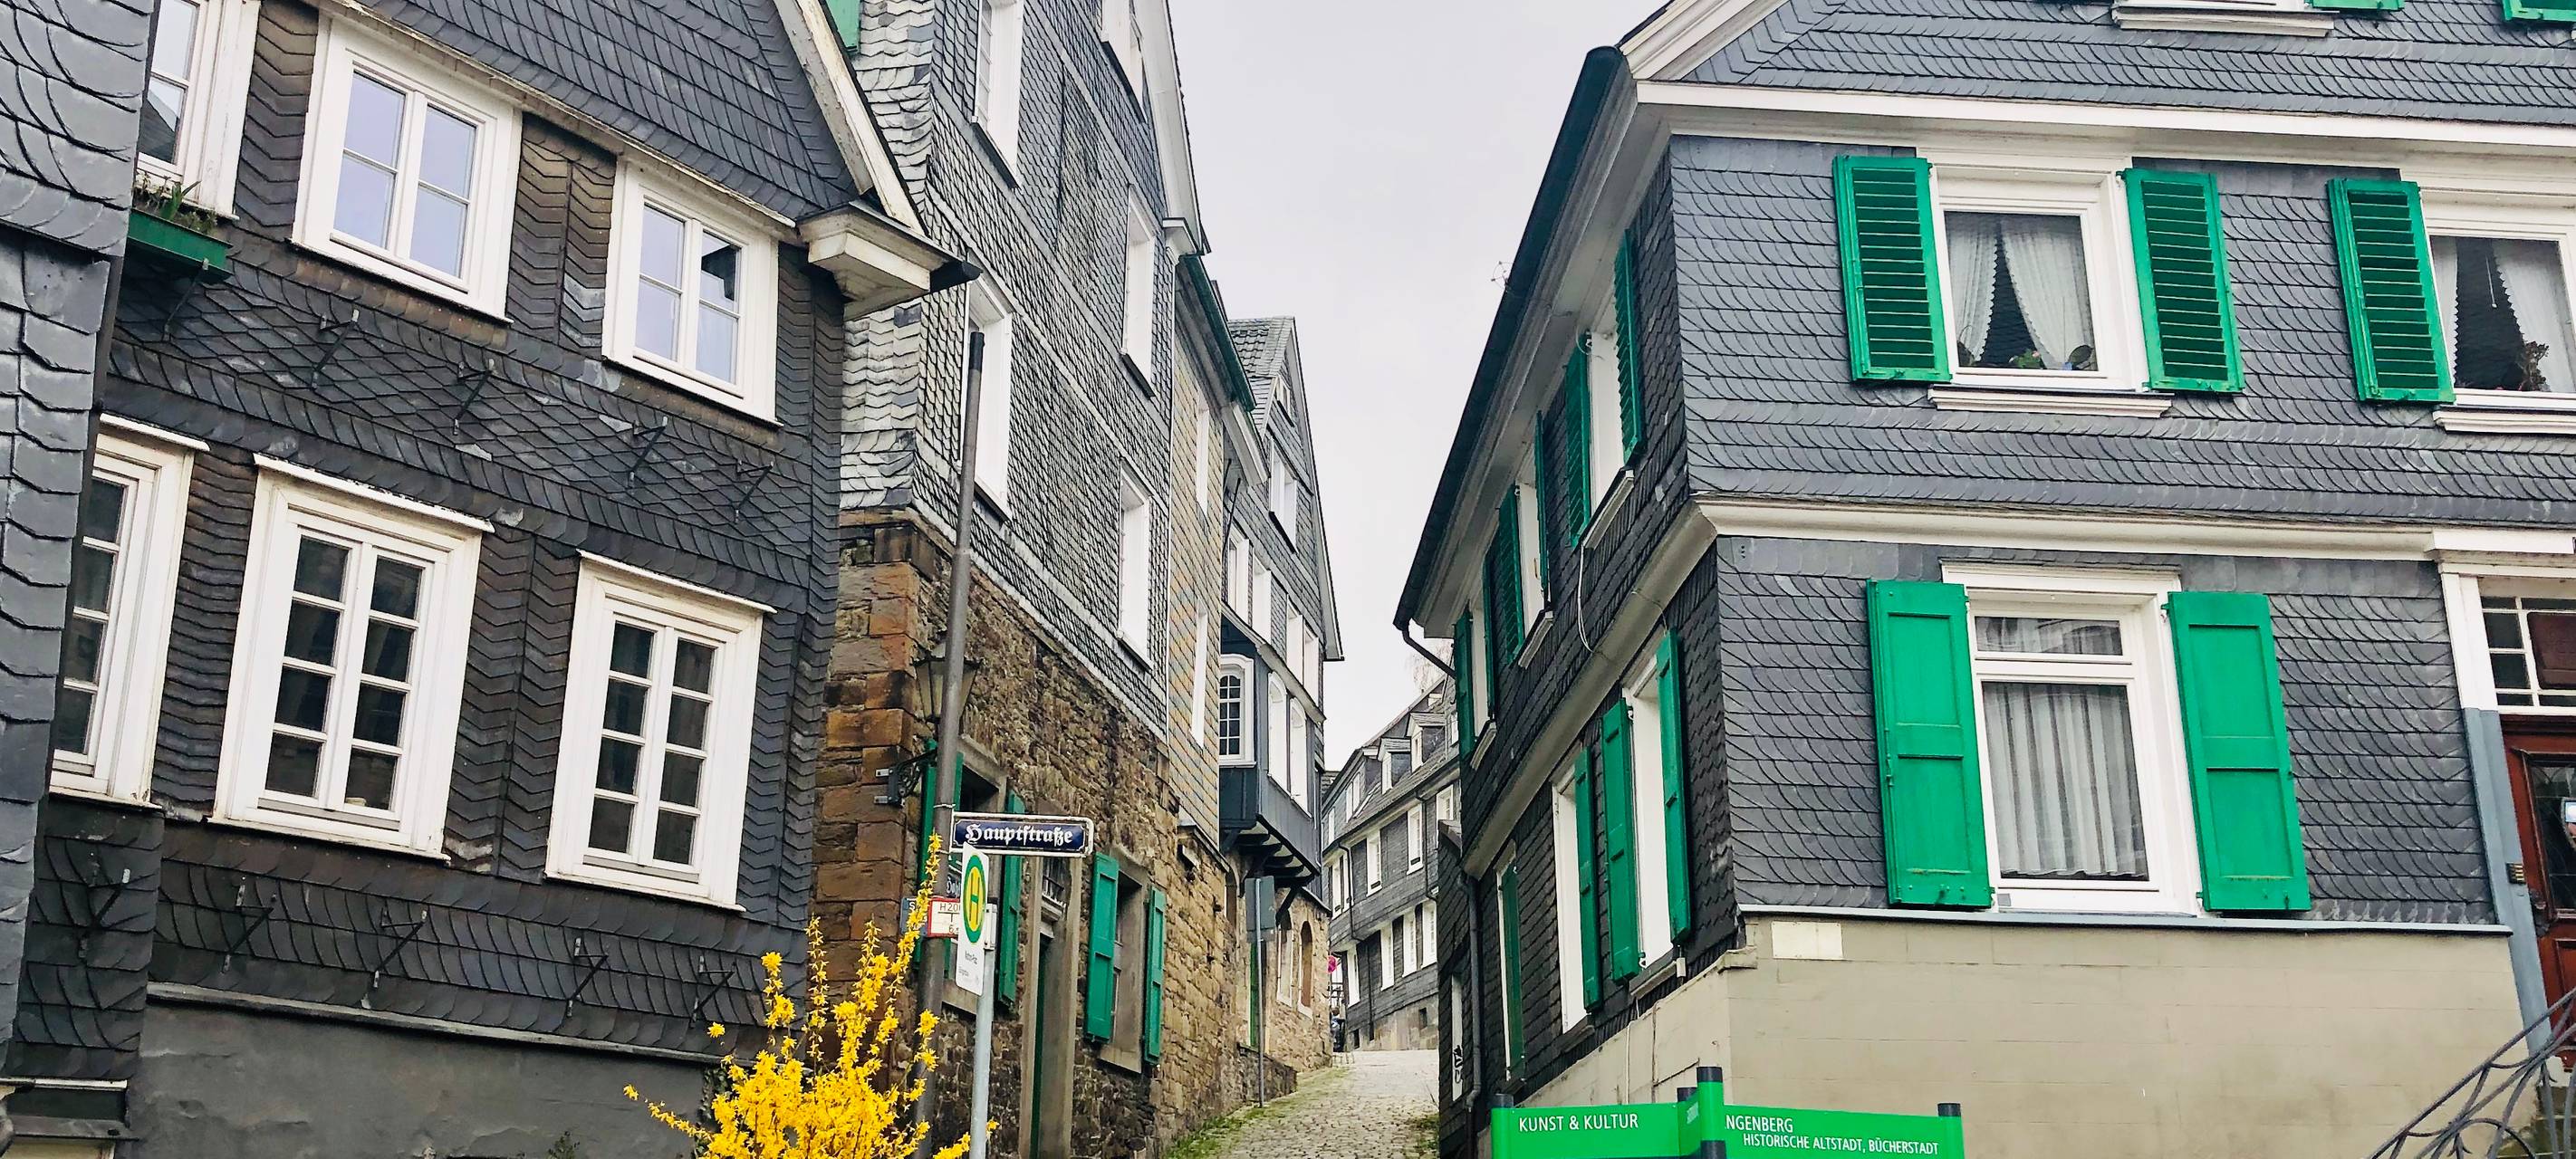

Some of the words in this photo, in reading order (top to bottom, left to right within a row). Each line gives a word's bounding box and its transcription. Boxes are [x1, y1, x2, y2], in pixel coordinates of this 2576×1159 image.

[939, 903, 960, 912] H20
[1519, 1116, 1564, 1132] KUNST
[1569, 1115, 1580, 1130] &
[1584, 1113, 1639, 1130] KULTUR
[1725, 1115, 1793, 1133] NGENBERG
[1743, 1133, 1810, 1149] HISTORISCHE
[1812, 1136, 1866, 1154] ALTSTADT,
[1869, 1137, 1939, 1155] BÜCHERSTADT
